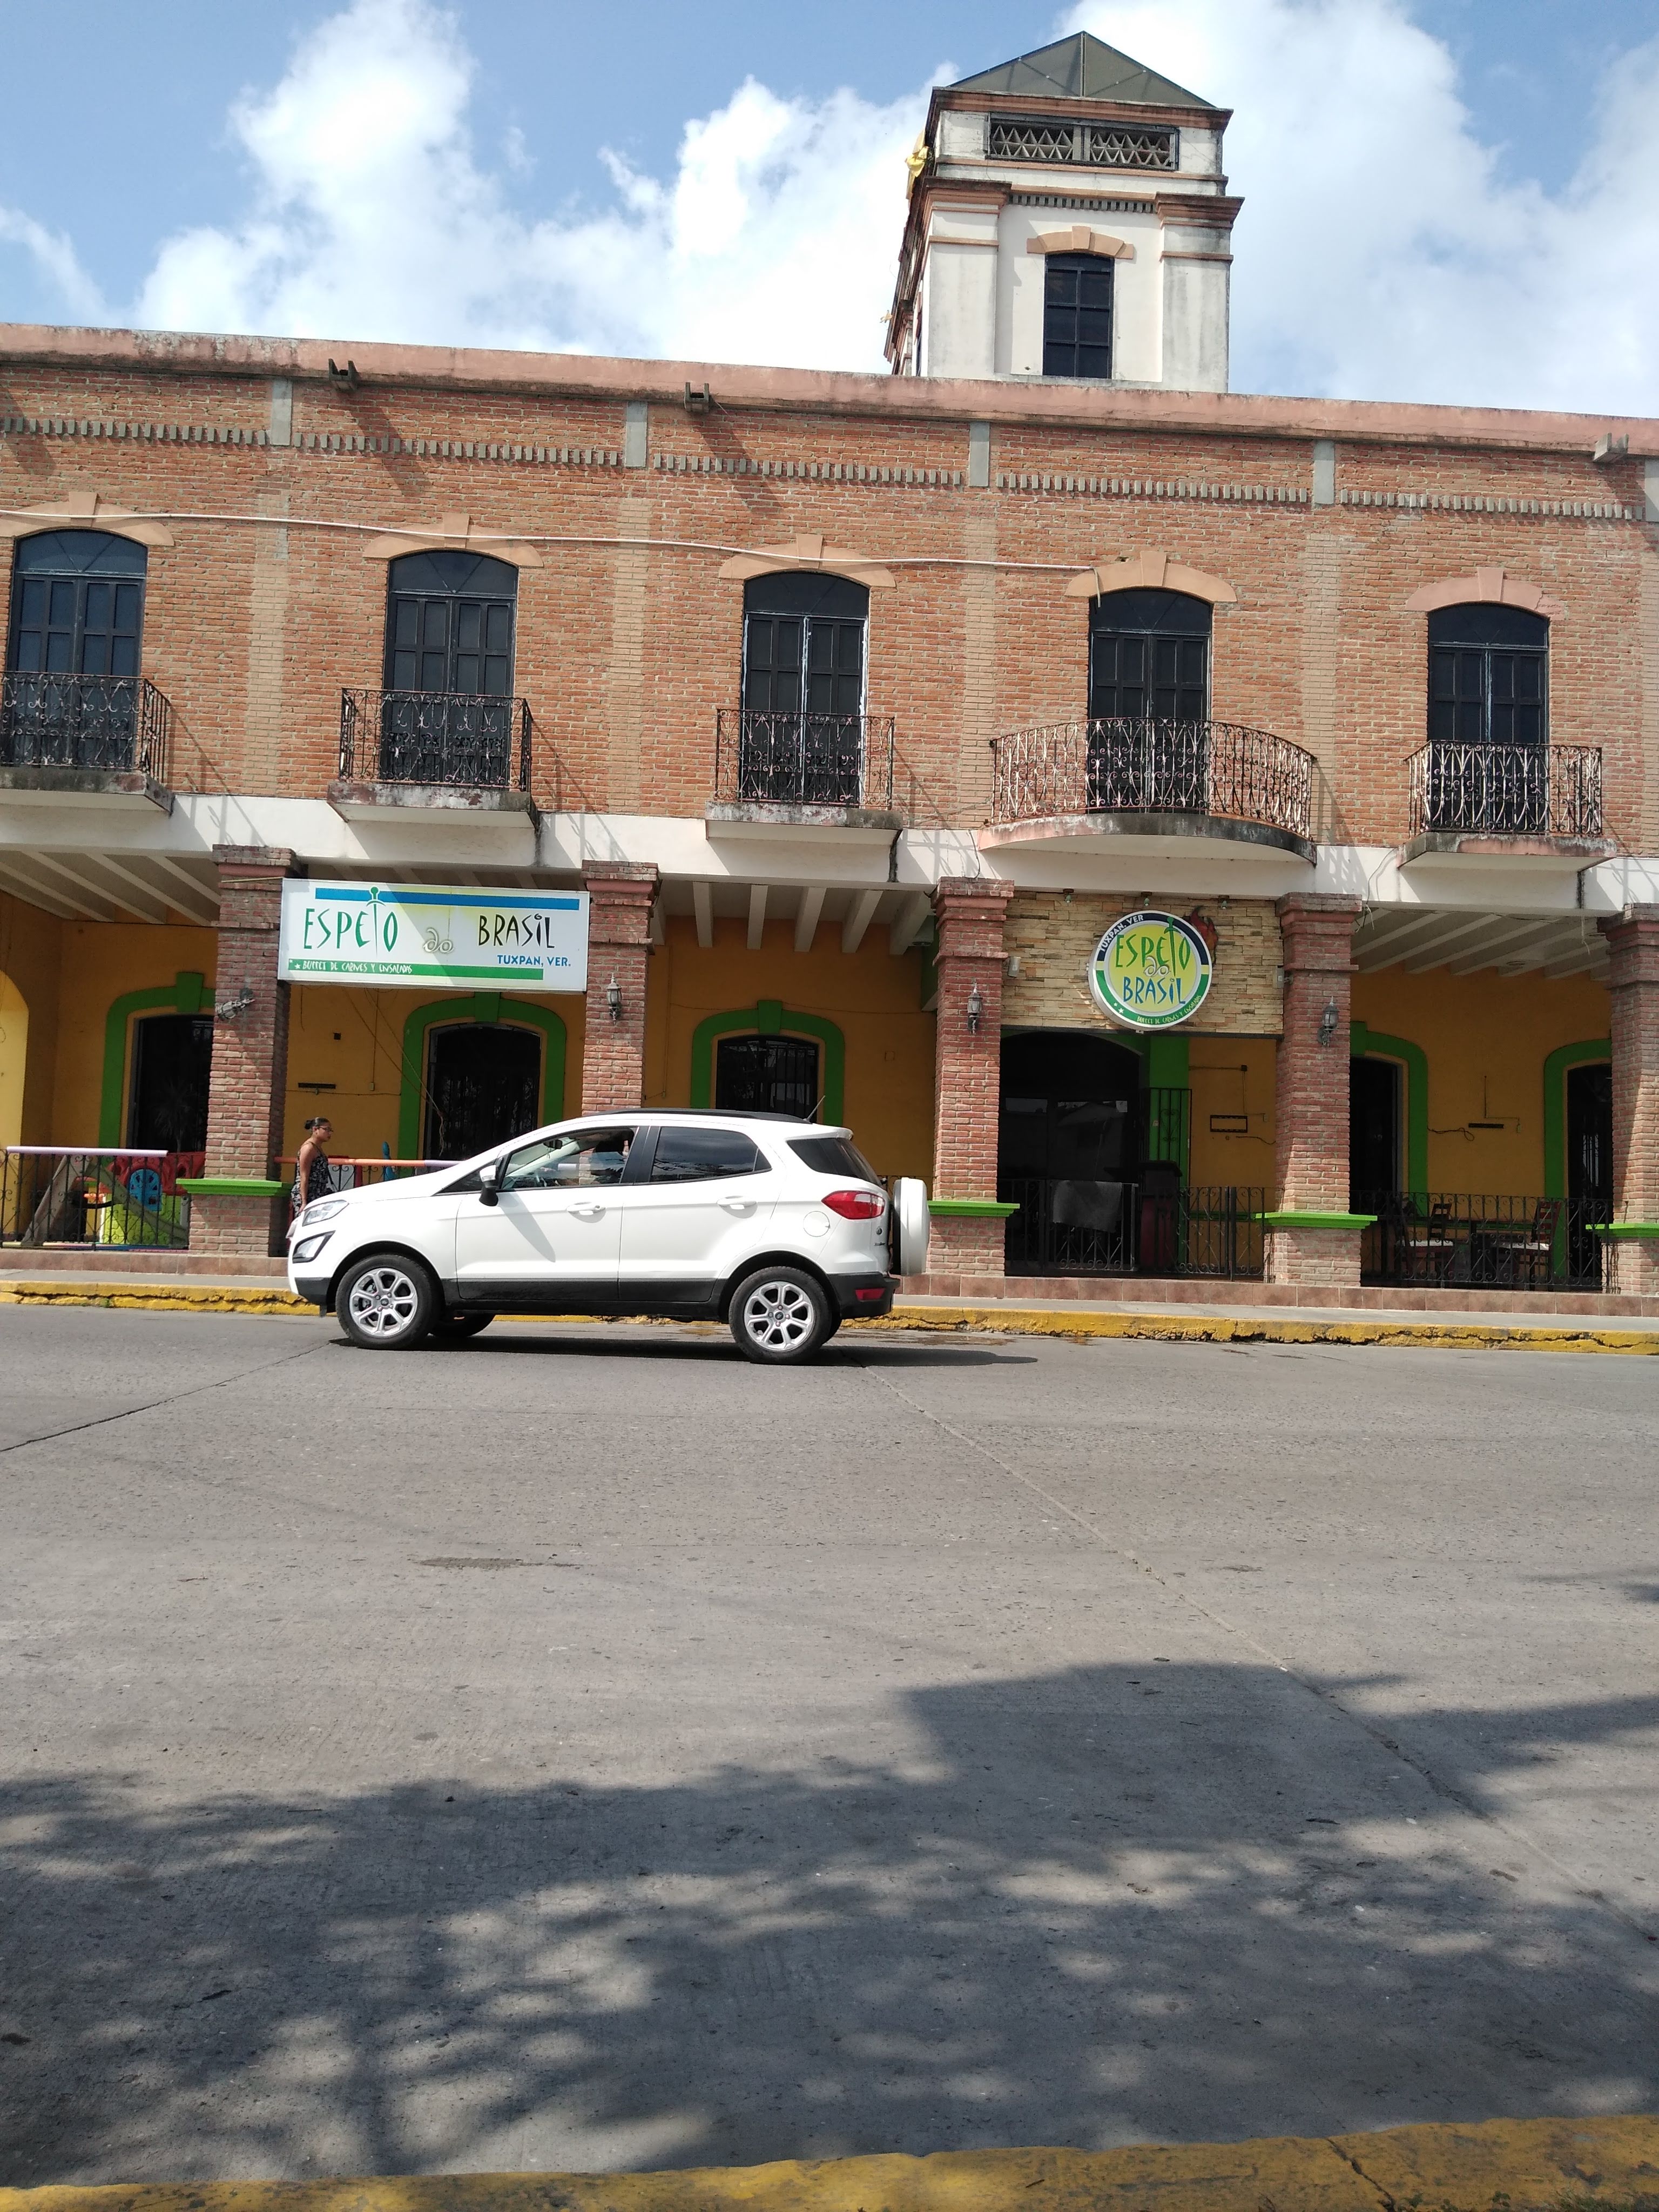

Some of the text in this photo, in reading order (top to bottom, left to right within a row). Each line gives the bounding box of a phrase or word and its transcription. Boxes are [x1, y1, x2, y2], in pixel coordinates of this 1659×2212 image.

[303, 887, 399, 957] ESPETO
[1126, 914, 1144, 925] VER
[1115, 916, 1191, 976] ESPETO
[302, 960, 413, 974] BUFFET DE CARNES Y ENSALADAS
[497, 954, 571, 967] TUXPAN, VER.
